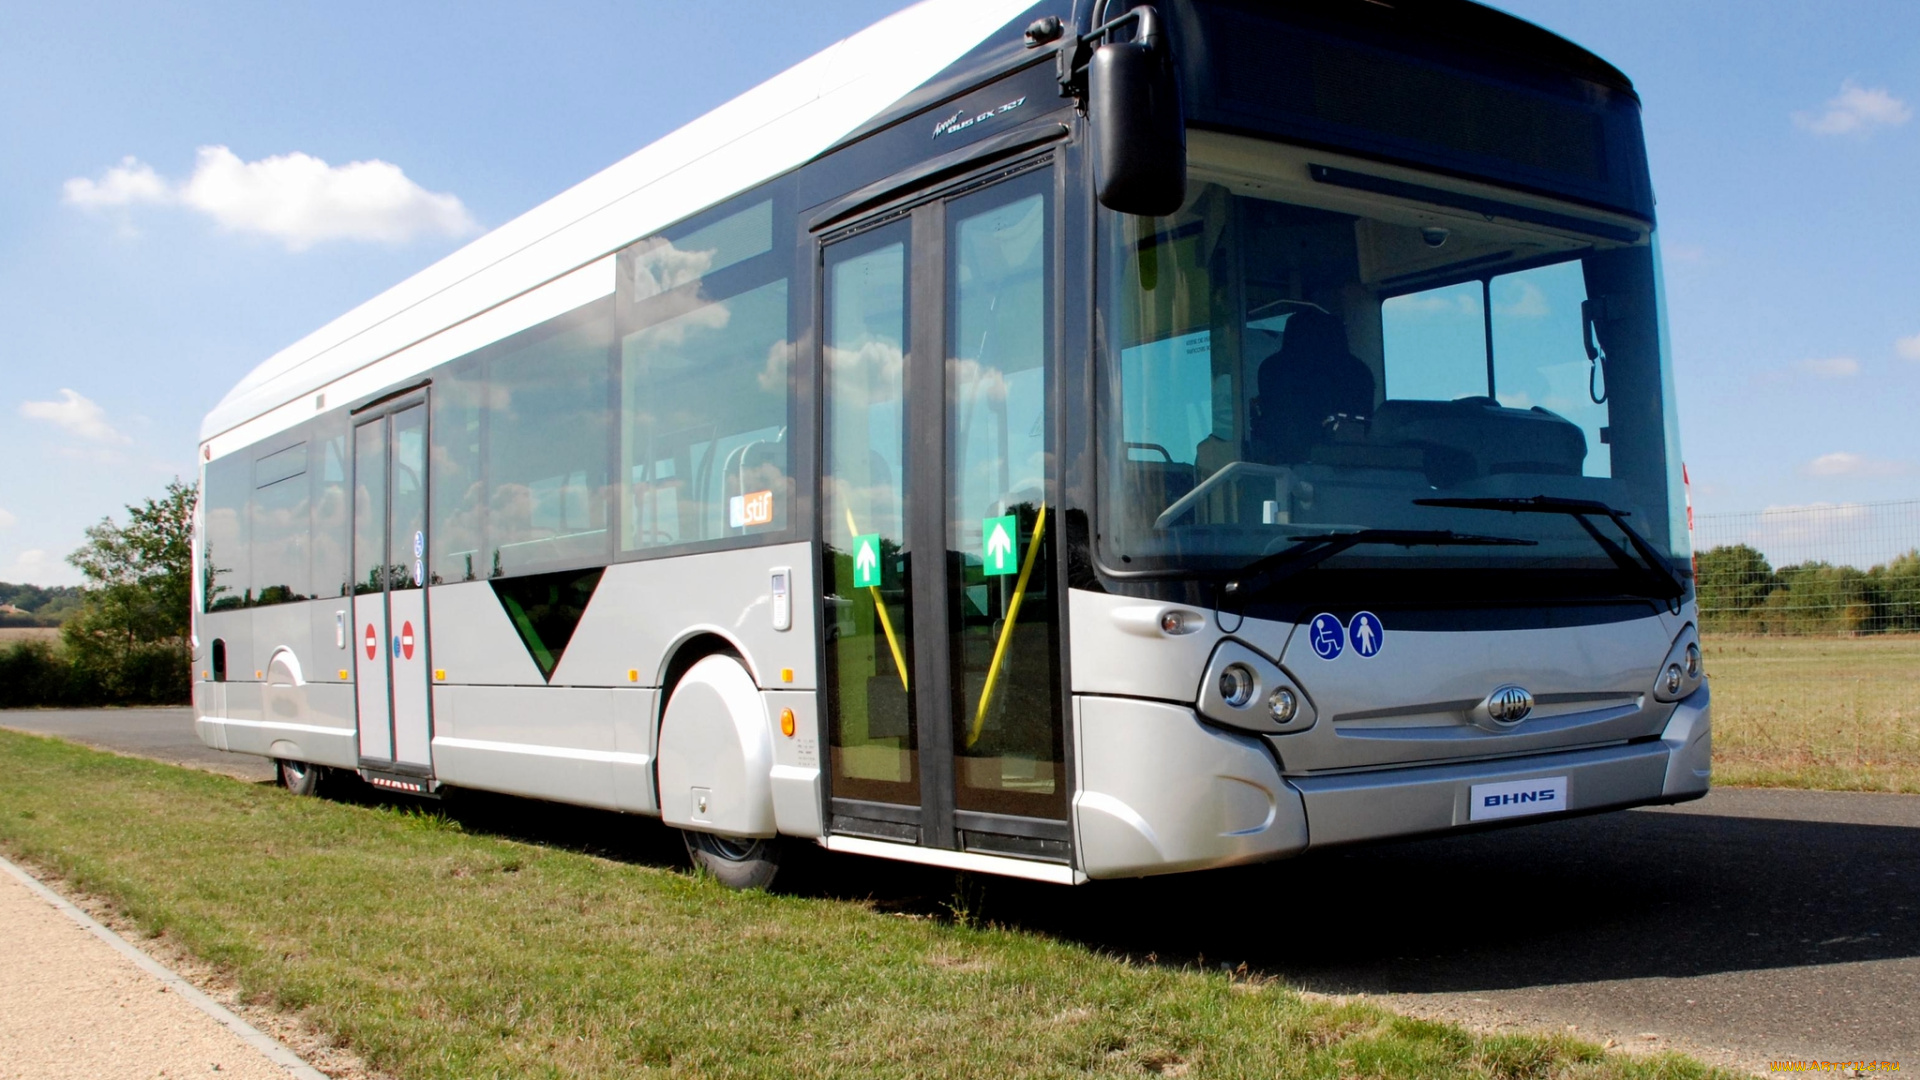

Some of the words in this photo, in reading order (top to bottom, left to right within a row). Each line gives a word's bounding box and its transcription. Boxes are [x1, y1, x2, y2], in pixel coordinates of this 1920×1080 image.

[976, 109, 995, 123] GX
[998, 95, 1026, 114] 327
[741, 491, 772, 522] stif
[1484, 789, 1555, 807] BHNS
